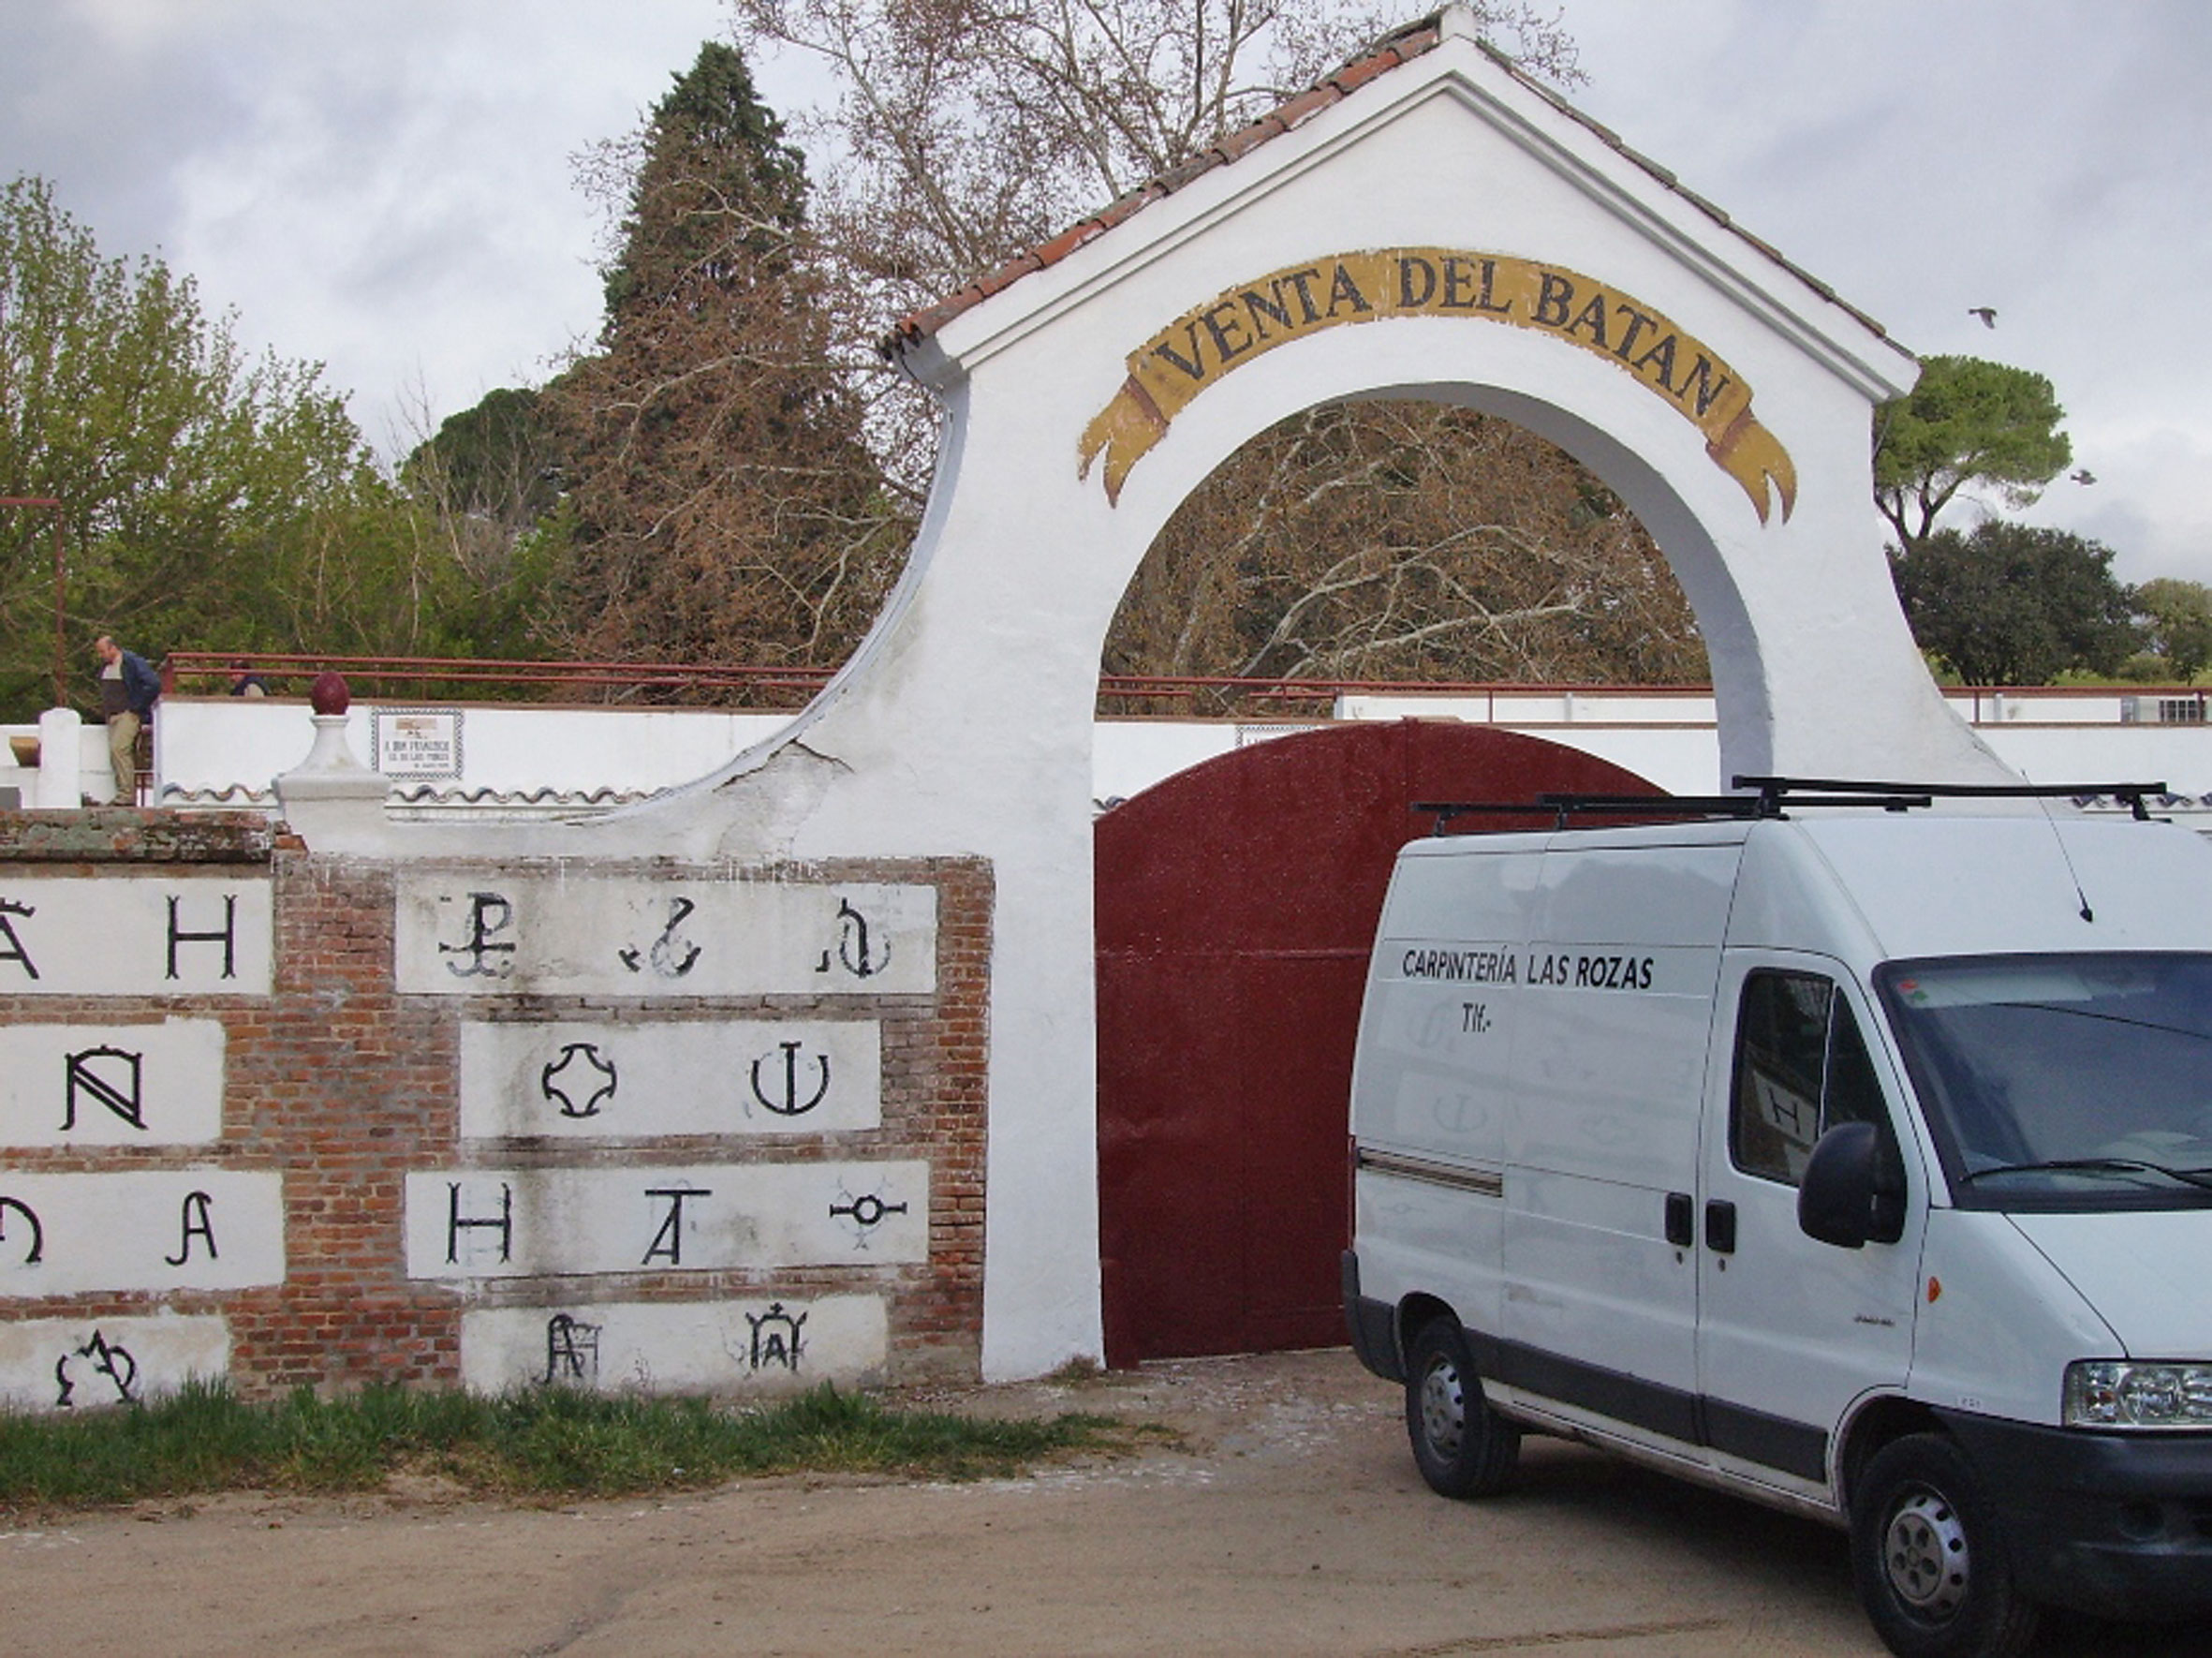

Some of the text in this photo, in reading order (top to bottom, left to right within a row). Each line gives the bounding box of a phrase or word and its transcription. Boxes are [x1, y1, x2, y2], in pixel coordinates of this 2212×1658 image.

[1150, 257, 1731, 419] VENTA DEL BATAN
[1403, 945, 1655, 989] CARPINTERÍA LAS ROZAS
